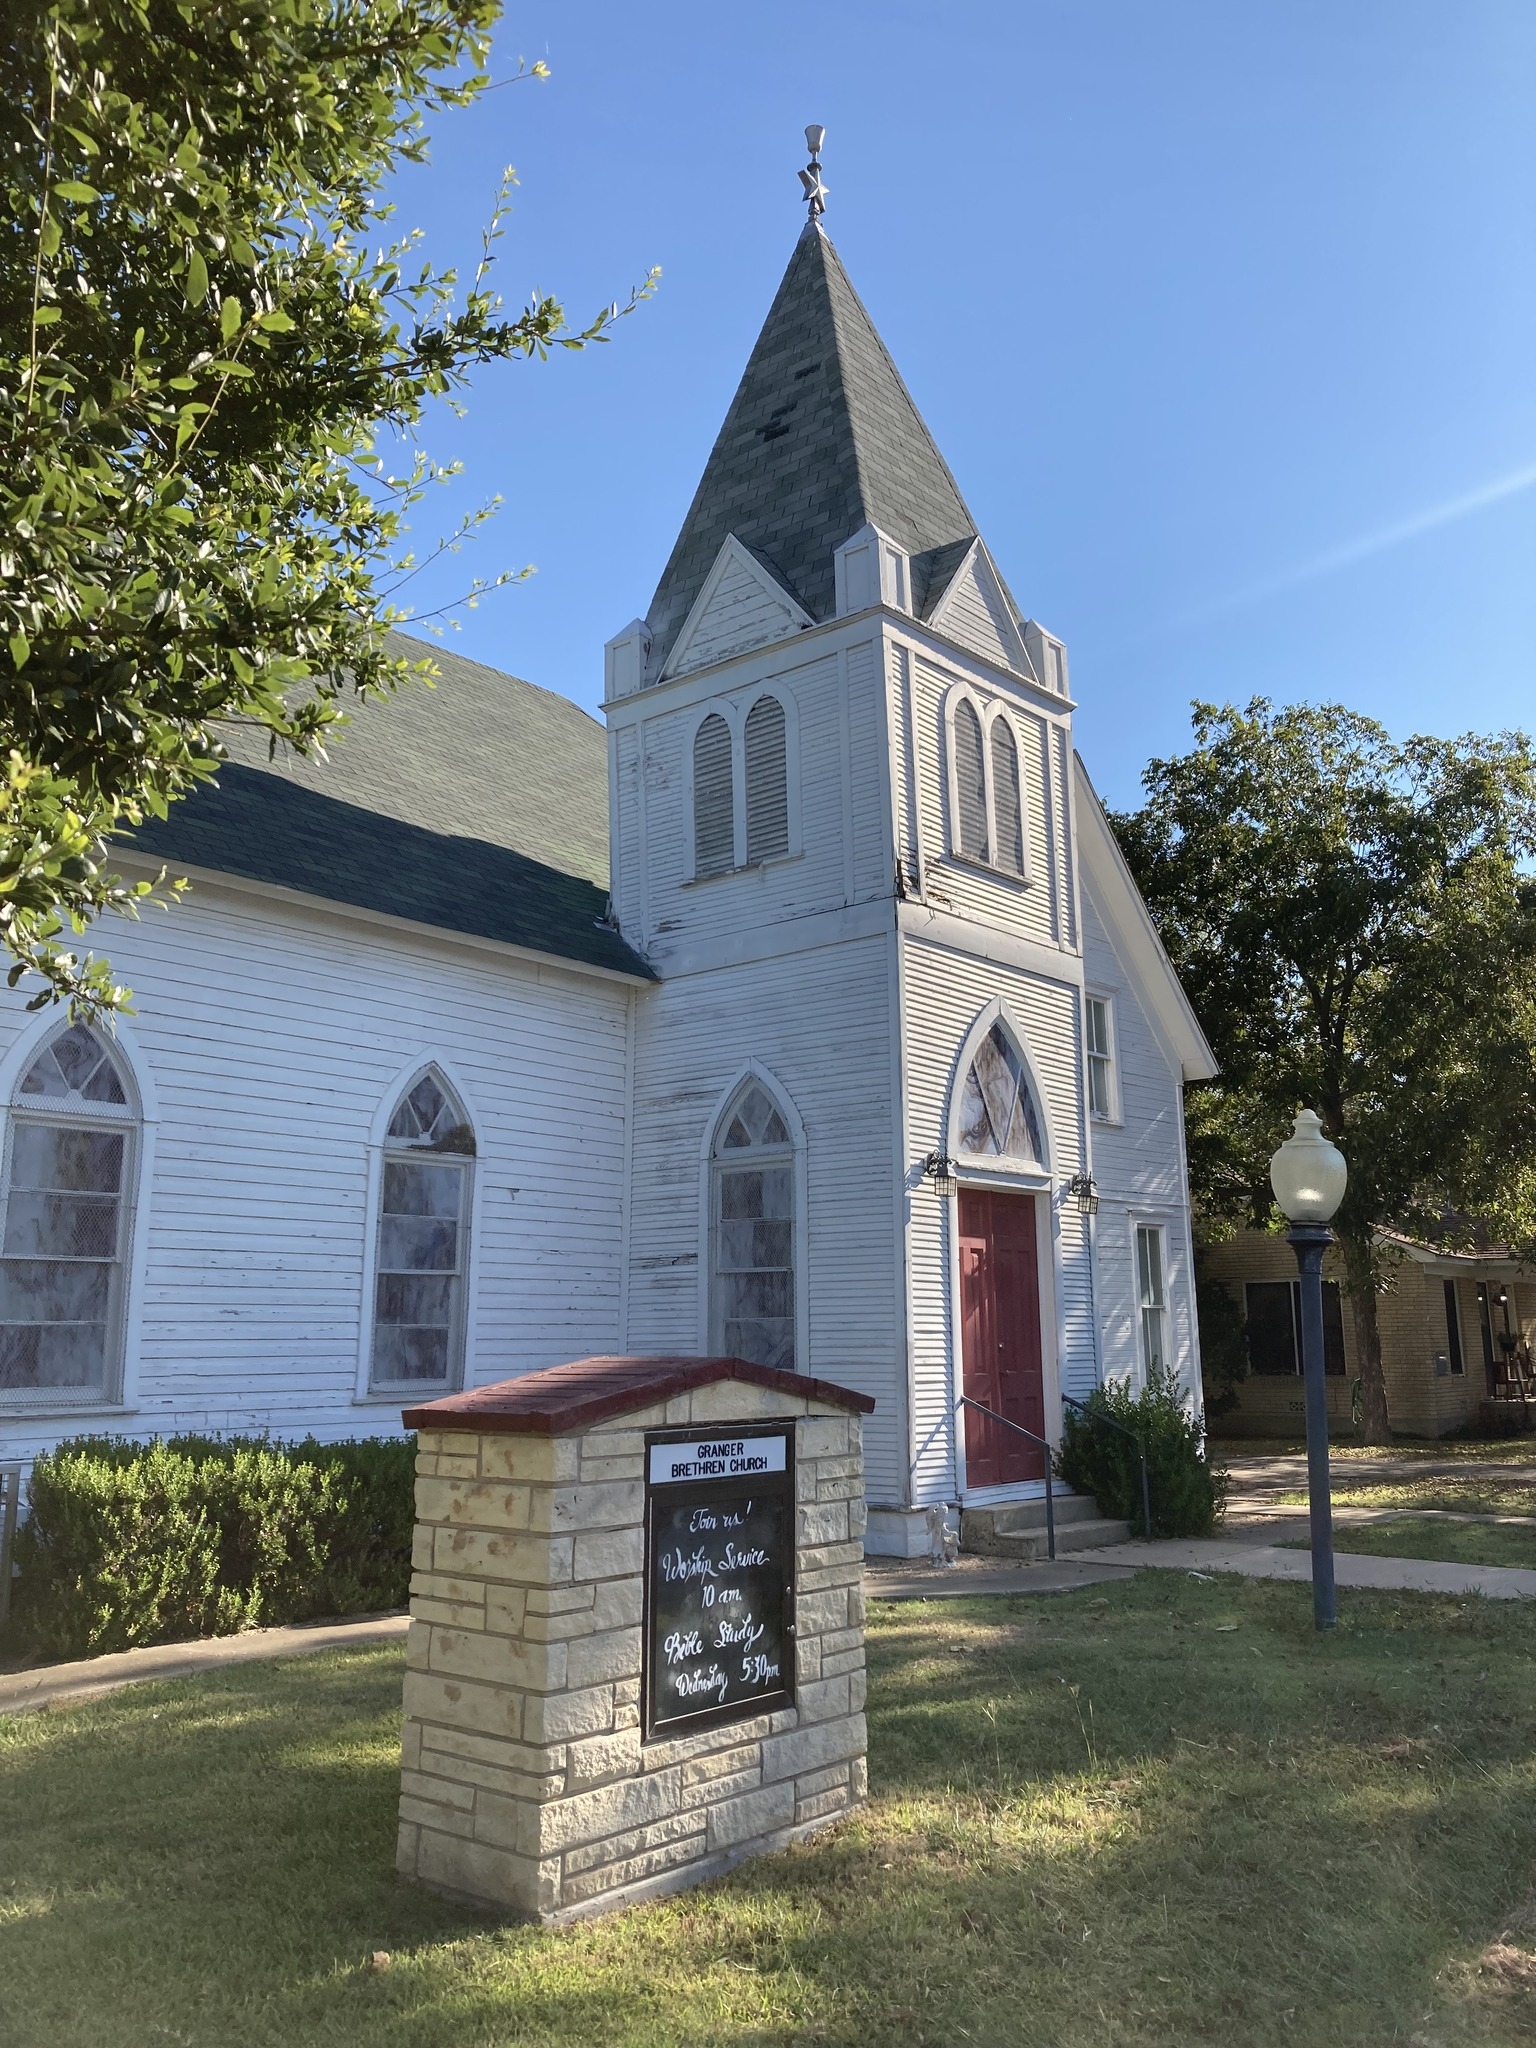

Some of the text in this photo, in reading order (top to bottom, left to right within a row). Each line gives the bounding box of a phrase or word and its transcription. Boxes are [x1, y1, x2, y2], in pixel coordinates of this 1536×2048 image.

[697, 1442, 744, 1459] GRANGER
[671, 1457, 768, 1478] BRETHREN CHURCH
[689, 1500, 752, 1533] Join us!
[662, 1542, 770, 1585] Worship Service
[702, 1584, 715, 1609] 10
[664, 1613, 764, 1666] Bible Study
[675, 1663, 728, 1702] Wednesday
